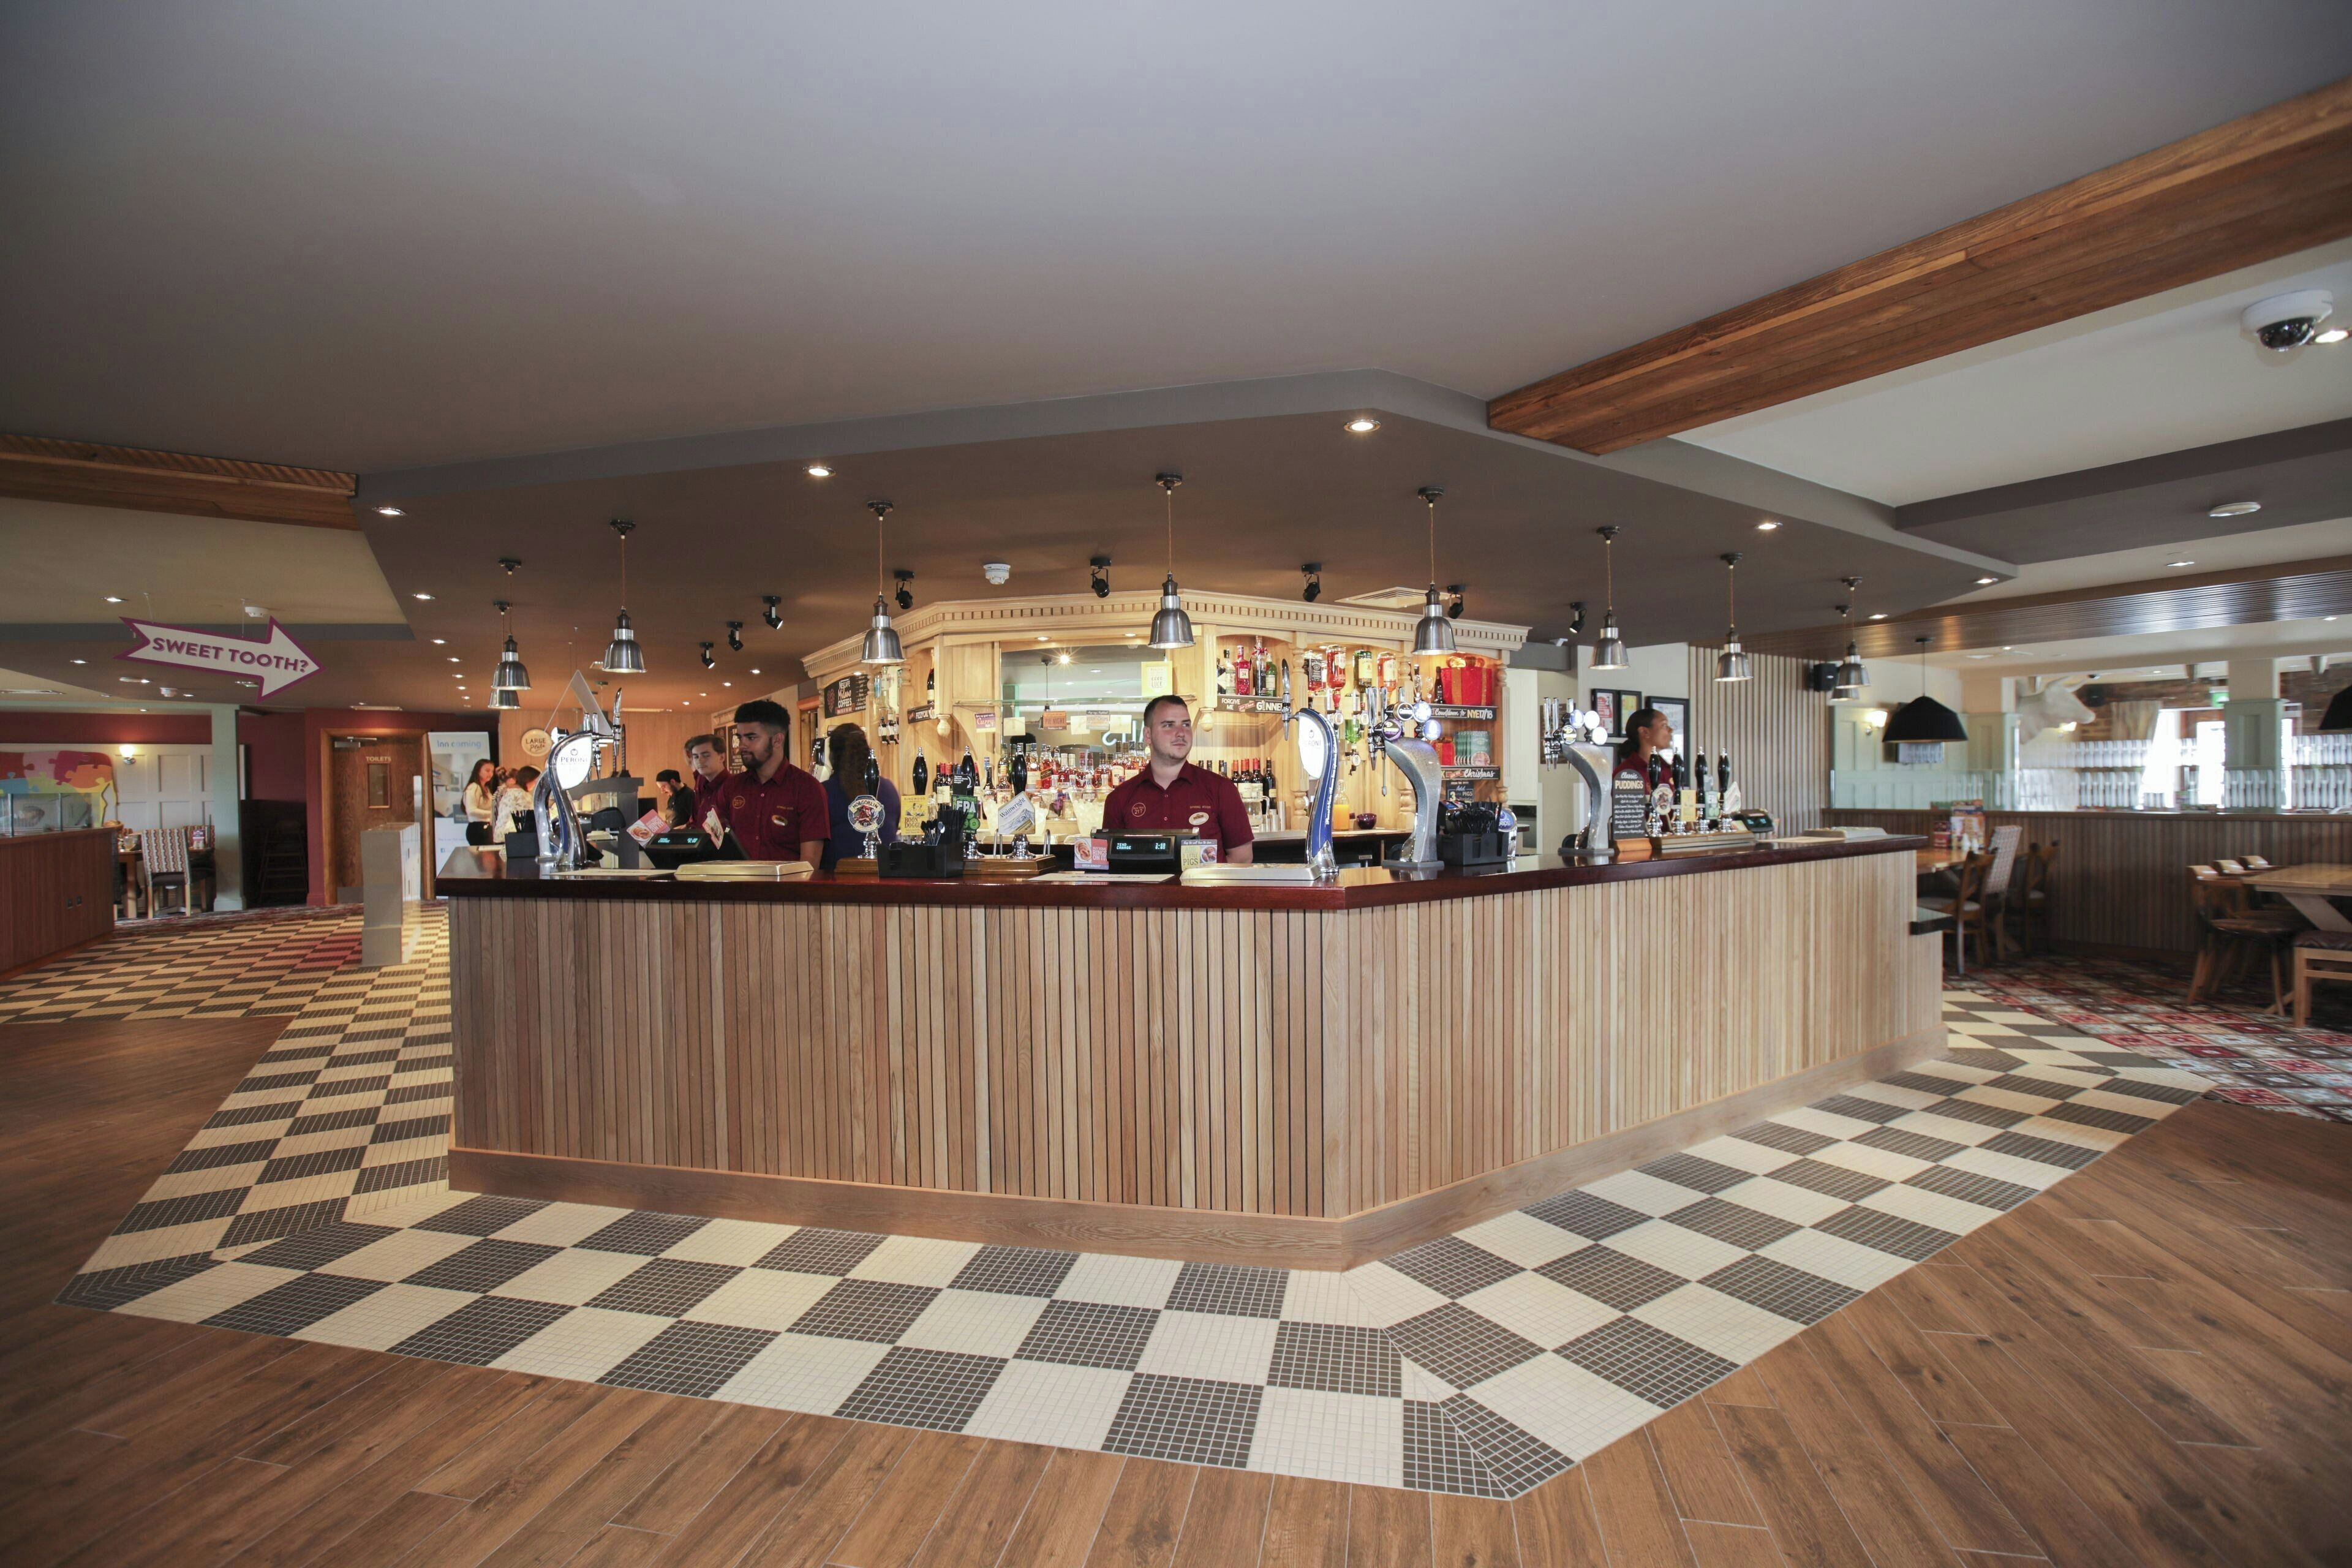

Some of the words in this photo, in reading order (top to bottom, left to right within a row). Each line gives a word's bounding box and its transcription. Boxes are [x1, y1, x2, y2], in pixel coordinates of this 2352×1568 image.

[153, 637, 224, 660] SWEET
[228, 649, 309, 673] TOOTH?
[838, 698, 852, 708] COFFEES
[1256, 700, 1283, 711] GINNE
[1435, 708, 1459, 718] Countdown
[976, 717, 994, 727] Curry
[451, 740, 482, 749] coming
[1464, 767, 1496, 780] Christmas
[1615, 780, 1644, 790] PUDDINGS
[1449, 791, 1456, 801] 3
[852, 800, 878, 809] HOBGOBLIN
[999, 797, 1026, 818] Wainwright
